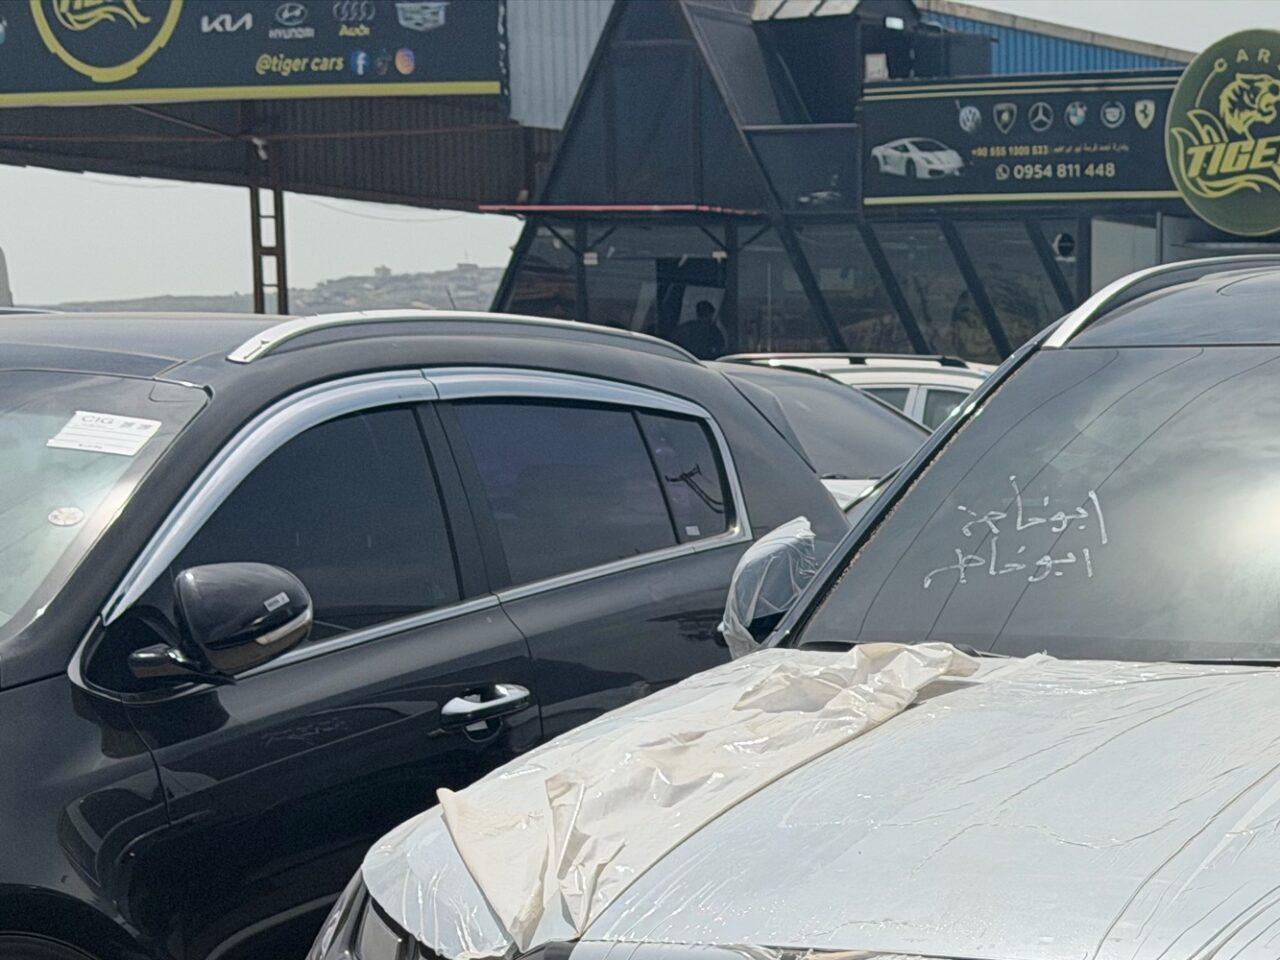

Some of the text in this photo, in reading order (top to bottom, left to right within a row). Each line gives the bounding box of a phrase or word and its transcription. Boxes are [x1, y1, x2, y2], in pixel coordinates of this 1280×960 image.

[255, 53, 344, 76] @tiger cars
[1013, 162, 1117, 180] 0954 811 448
